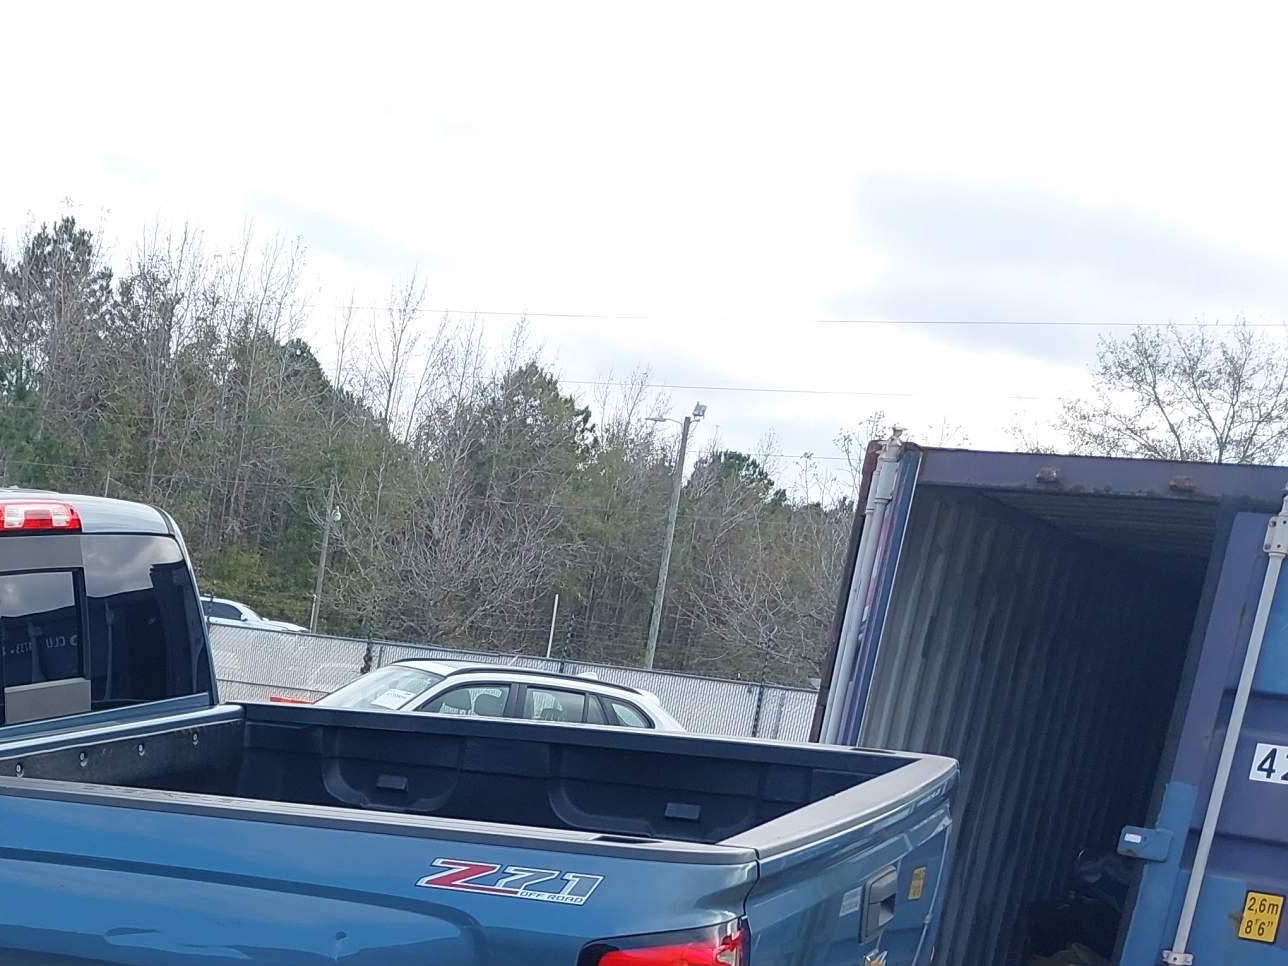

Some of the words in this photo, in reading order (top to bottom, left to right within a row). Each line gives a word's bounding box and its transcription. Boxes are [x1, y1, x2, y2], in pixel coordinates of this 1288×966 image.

[415, 857, 605, 900] Z71
[519, 890, 544, 898] OFF
[546, 893, 583, 903] ROAD
